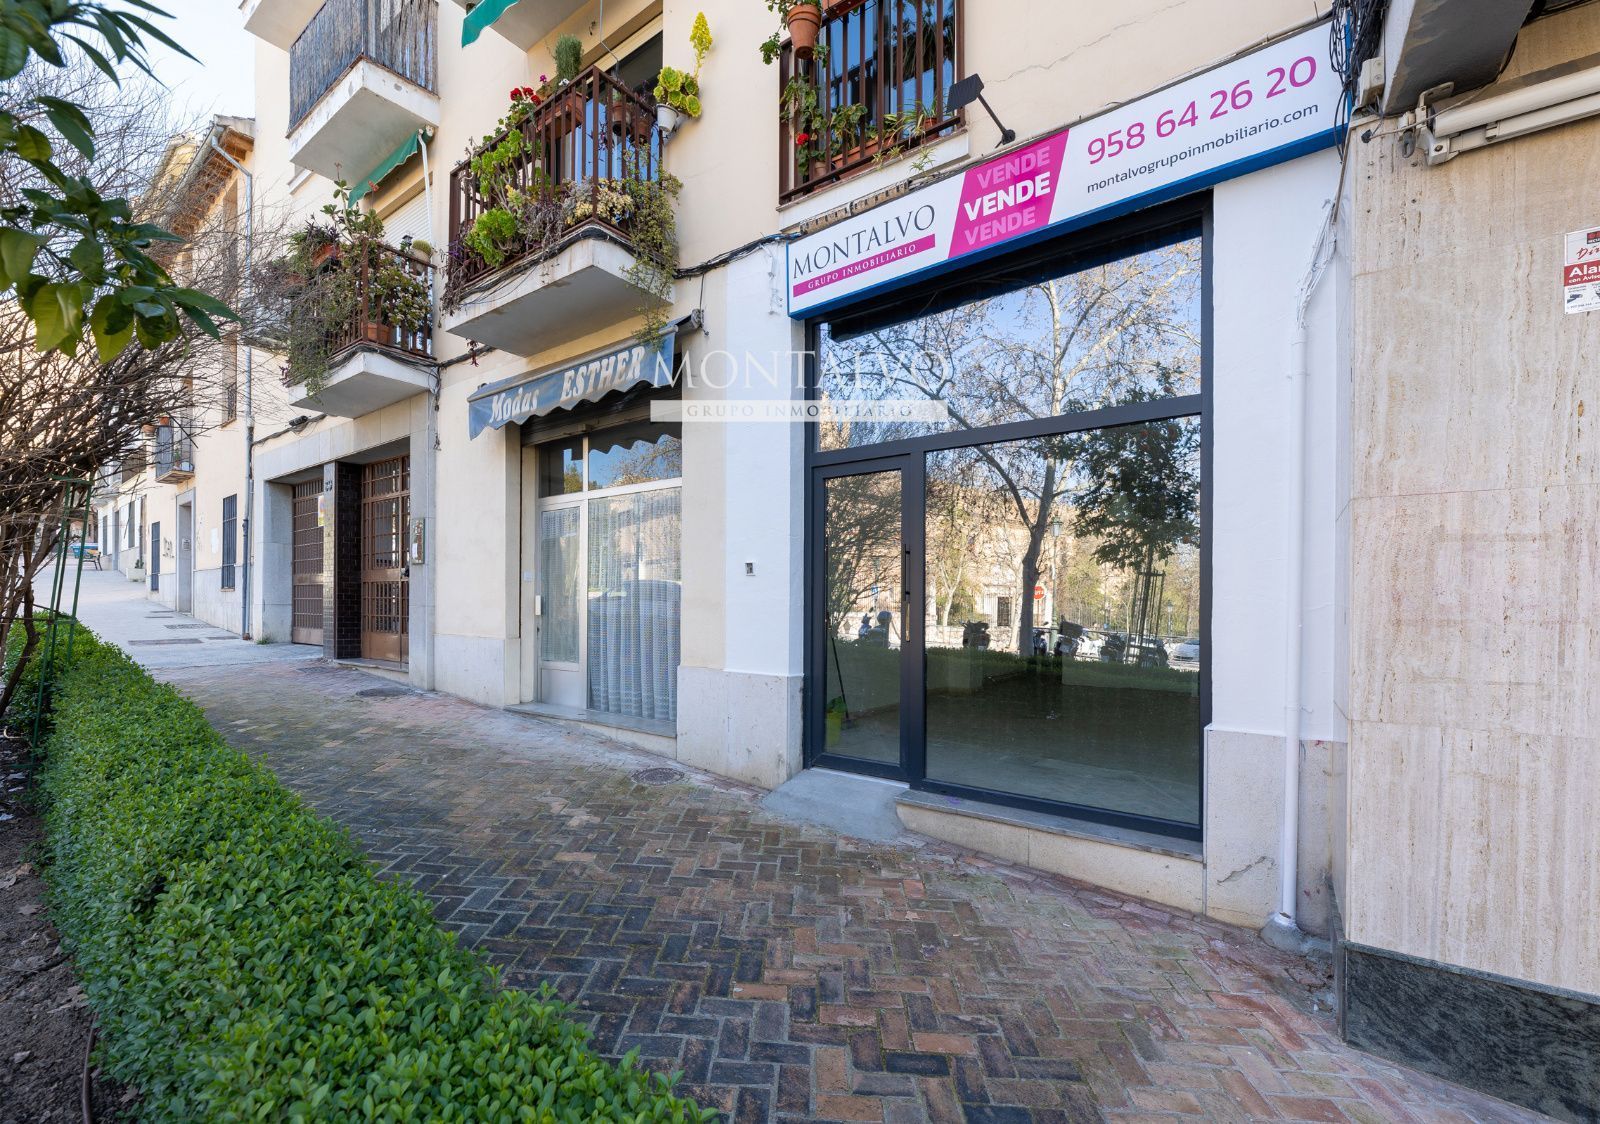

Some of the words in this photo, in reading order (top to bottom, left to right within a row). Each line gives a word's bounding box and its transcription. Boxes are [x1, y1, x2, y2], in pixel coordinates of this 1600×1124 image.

[1087, 122, 1145, 165] 958
[1156, 101, 1199, 138] 64
[1209, 80, 1253, 120] 26
[1266, 56, 1317, 98] 20
[977, 146, 1050, 189] VENDE
[1087, 104, 1318, 193] montalvogrupoinmobiliario.com
[964, 171, 1050, 221] VENDE
[965, 206, 1036, 245] VENDE
[794, 204, 935, 279] MONTALVO
[807, 273, 838, 289] GRUPO
[843, 244, 916, 277] INMOBILIARIO
[489, 387, 539, 424] Modas
[560, 346, 645, 400] ESTHER
